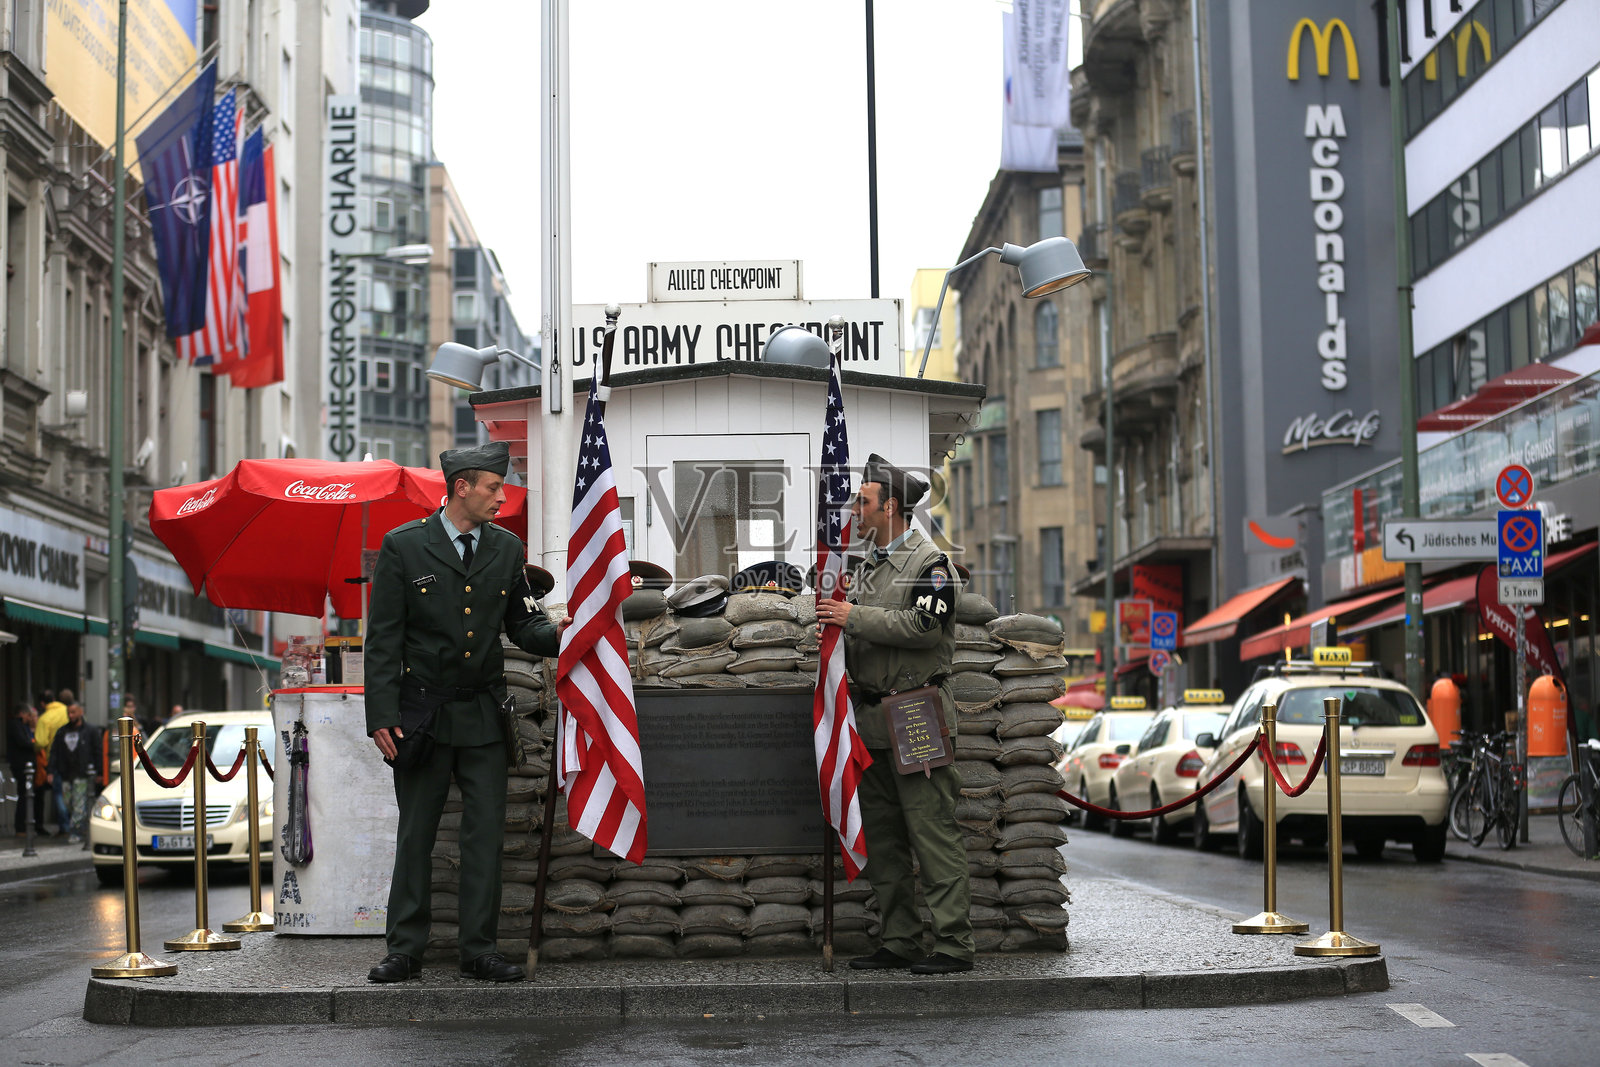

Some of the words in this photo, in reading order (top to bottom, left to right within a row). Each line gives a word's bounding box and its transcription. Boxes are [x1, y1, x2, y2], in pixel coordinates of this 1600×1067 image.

[330, 106, 356, 238] CHARLIE
[1304, 104, 1348, 391] McDonalds
[667, 268, 705, 291] ALLIED
[710, 267, 782, 290] CHECKPOINT
[330, 250, 356, 456] CHECKPOINT
[623, 324, 702, 365] ARMY
[1283, 409, 1379, 450] McCafé
[176, 487, 218, 516] Coca-Cola
[285, 480, 356, 500] Coca-Cola
[1422, 533, 1477, 548] Jüdisches
[1481, 533, 1497, 547] Mu
[1502, 557, 1539, 573] TAXI
[1504, 585, 1510, 597] 5
[1512, 585, 1539, 597] Taxen
[916, 595, 948, 615] MP
[1319, 651, 1349, 662] TAXI
